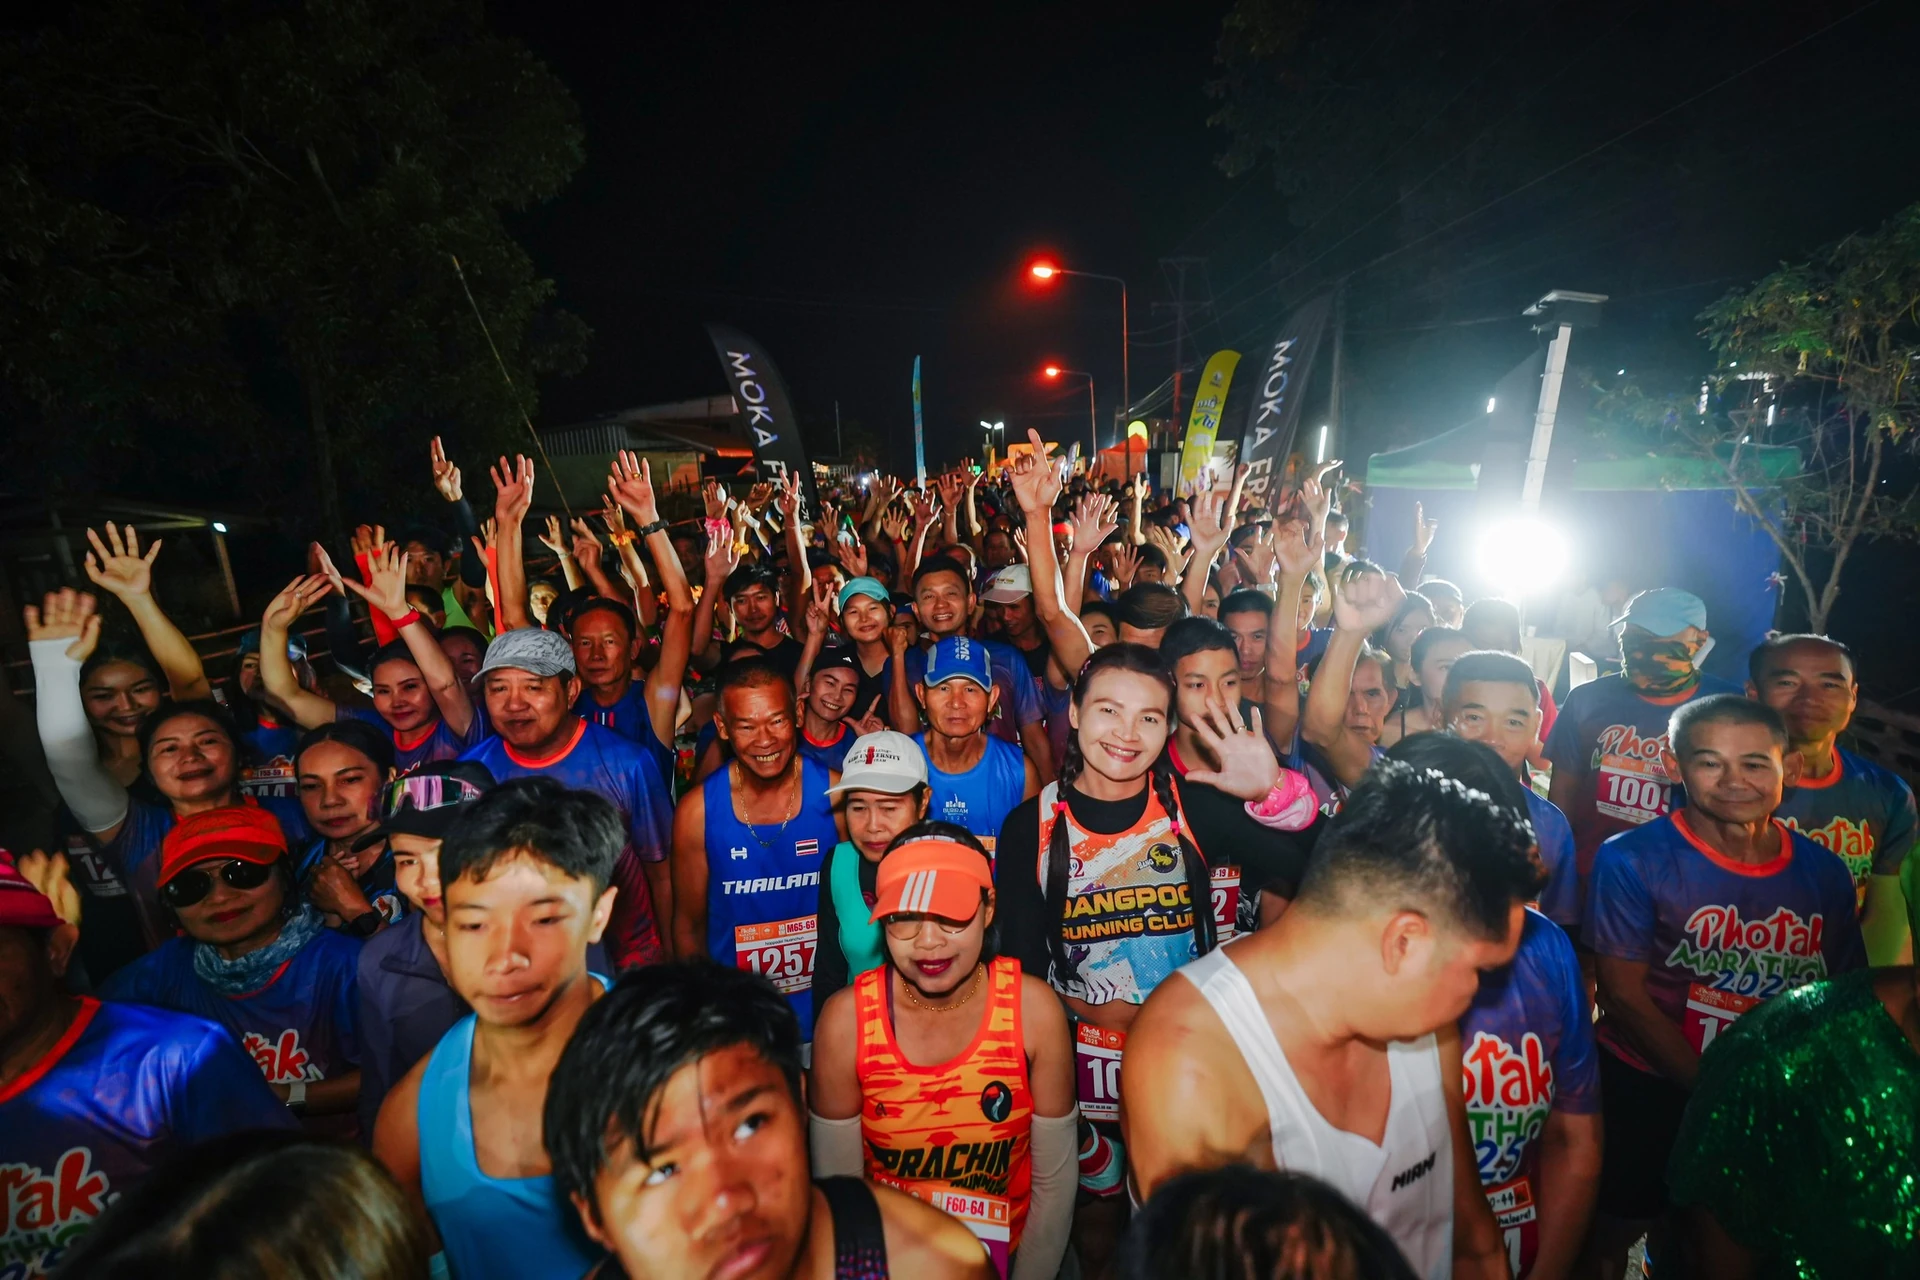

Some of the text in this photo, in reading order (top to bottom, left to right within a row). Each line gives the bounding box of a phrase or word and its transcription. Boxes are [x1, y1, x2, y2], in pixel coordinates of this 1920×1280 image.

[727, 351, 778, 447] MOKA
[1252, 336, 1297, 450] MOKA
[722, 871, 820, 894] THAILAN
[787, 920, 815, 933] M65-69
[747, 941, 817, 979] 1257
[946, 1197, 985, 1217] F60-64
